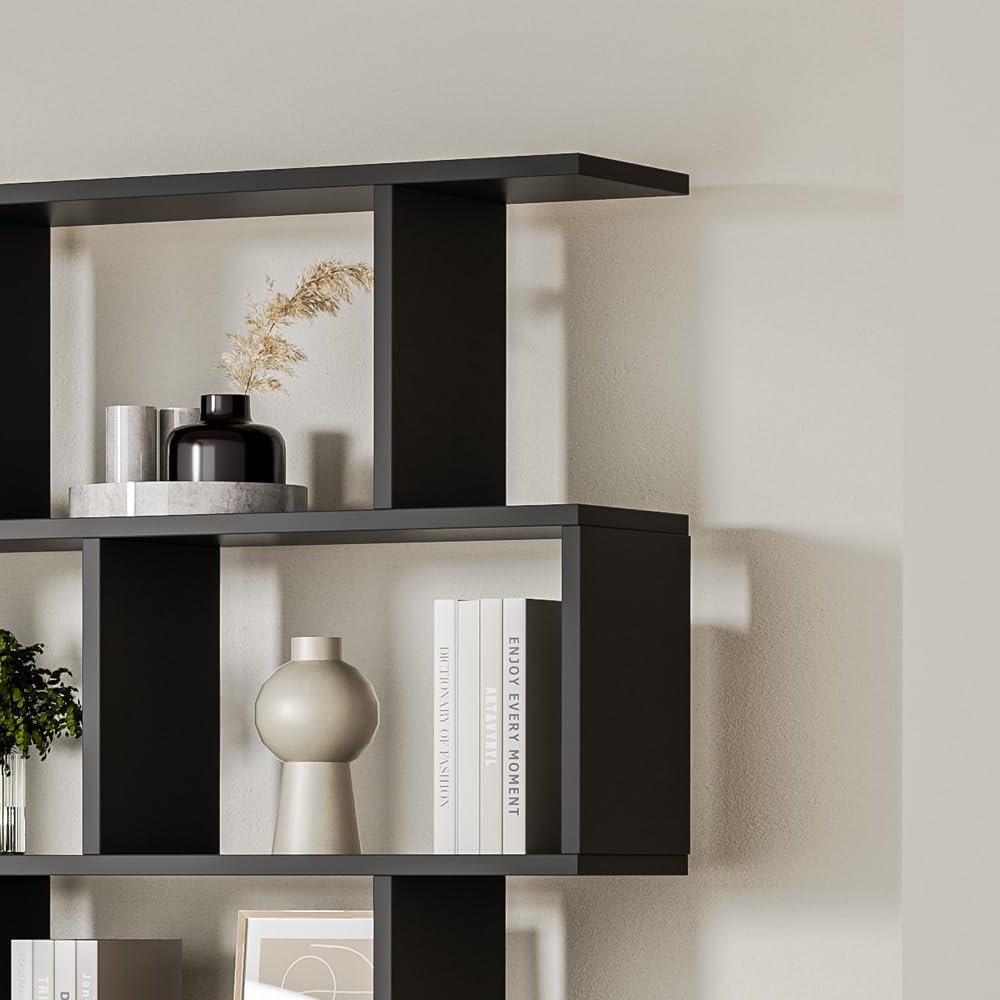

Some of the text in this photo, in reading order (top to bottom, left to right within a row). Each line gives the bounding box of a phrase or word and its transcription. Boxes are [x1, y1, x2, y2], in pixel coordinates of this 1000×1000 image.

[439, 645, 450, 809] DICTIONARY OF FASHION
[508, 636, 520, 817] ENJOY EVERY MOMENT
